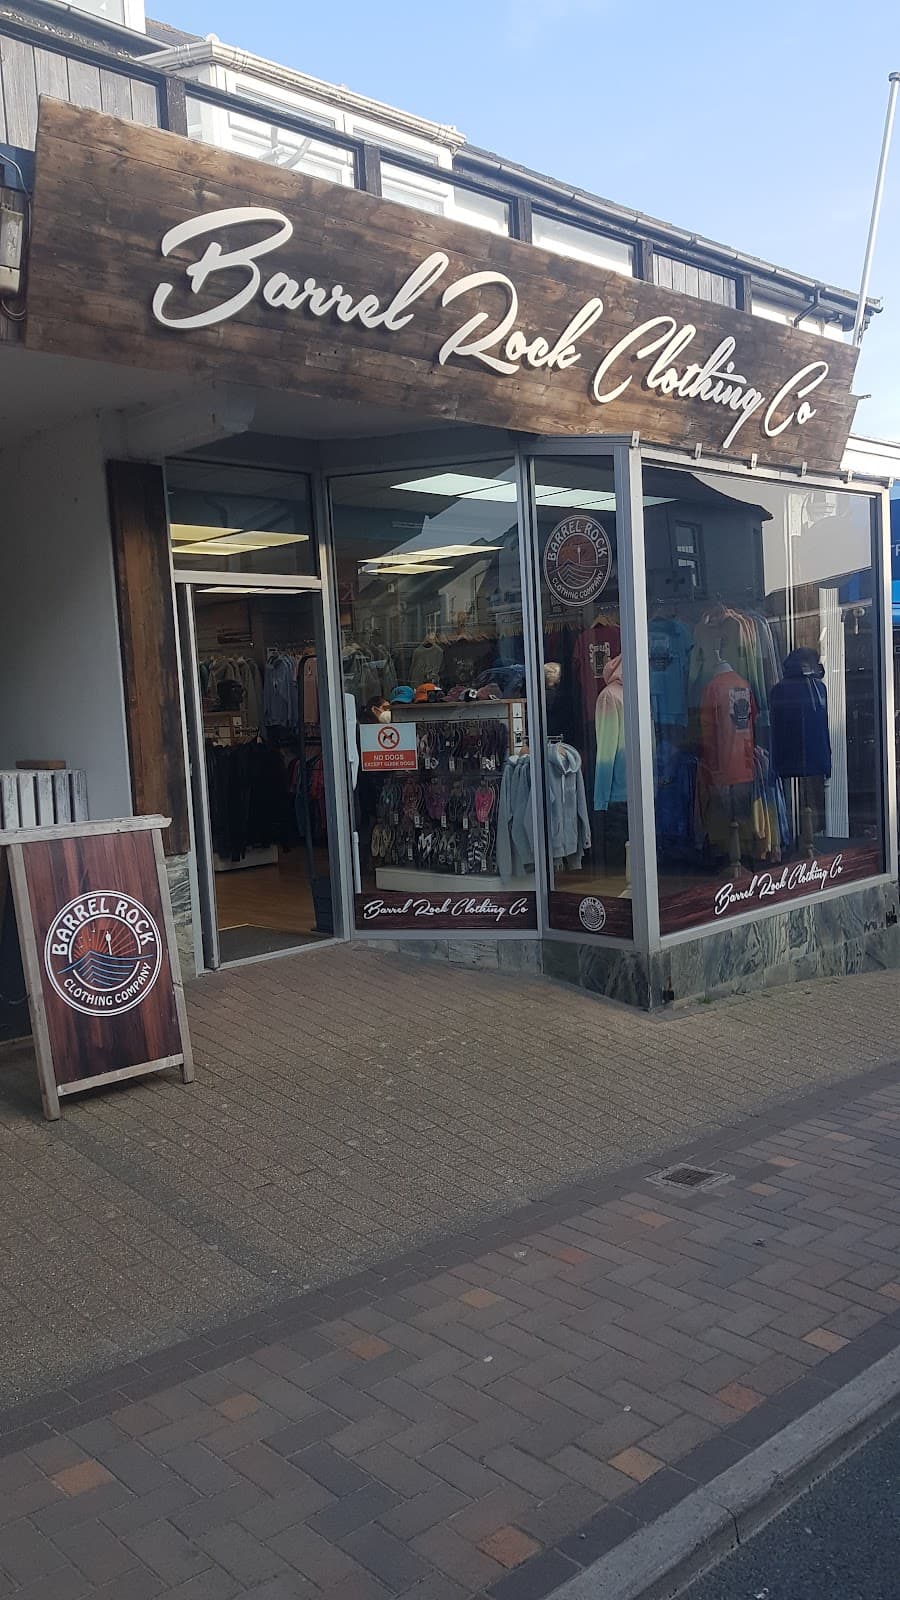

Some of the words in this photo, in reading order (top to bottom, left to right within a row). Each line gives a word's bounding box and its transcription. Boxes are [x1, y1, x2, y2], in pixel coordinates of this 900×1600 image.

[152, 206, 450, 331] Barrel
[438, 271, 604, 375] Rock
[591, 315, 765, 449] Clothing
[763, 360, 829, 438] Co
[547, 520, 581, 561] BARREL
[584, 523, 608, 557] ROCK
[552, 577, 579, 599] CLOTHING
[579, 570, 604, 598] COMPANY
[714, 874, 758, 915] Barrel
[757, 867, 789, 898] Rock
[787, 860, 828, 890] Clothing
[829, 853, 843, 879] Co
[51, 897, 110, 956] BARREL
[115, 900, 155, 946] ROCK
[363, 898, 413, 920] Barrel
[413, 898, 450, 917] Rock
[450, 898, 507, 921] Clothing
[508, 897, 528, 916] Co
[63, 978, 113, 1006] CLOTHING
[114, 962, 152, 1003] COMPANY
